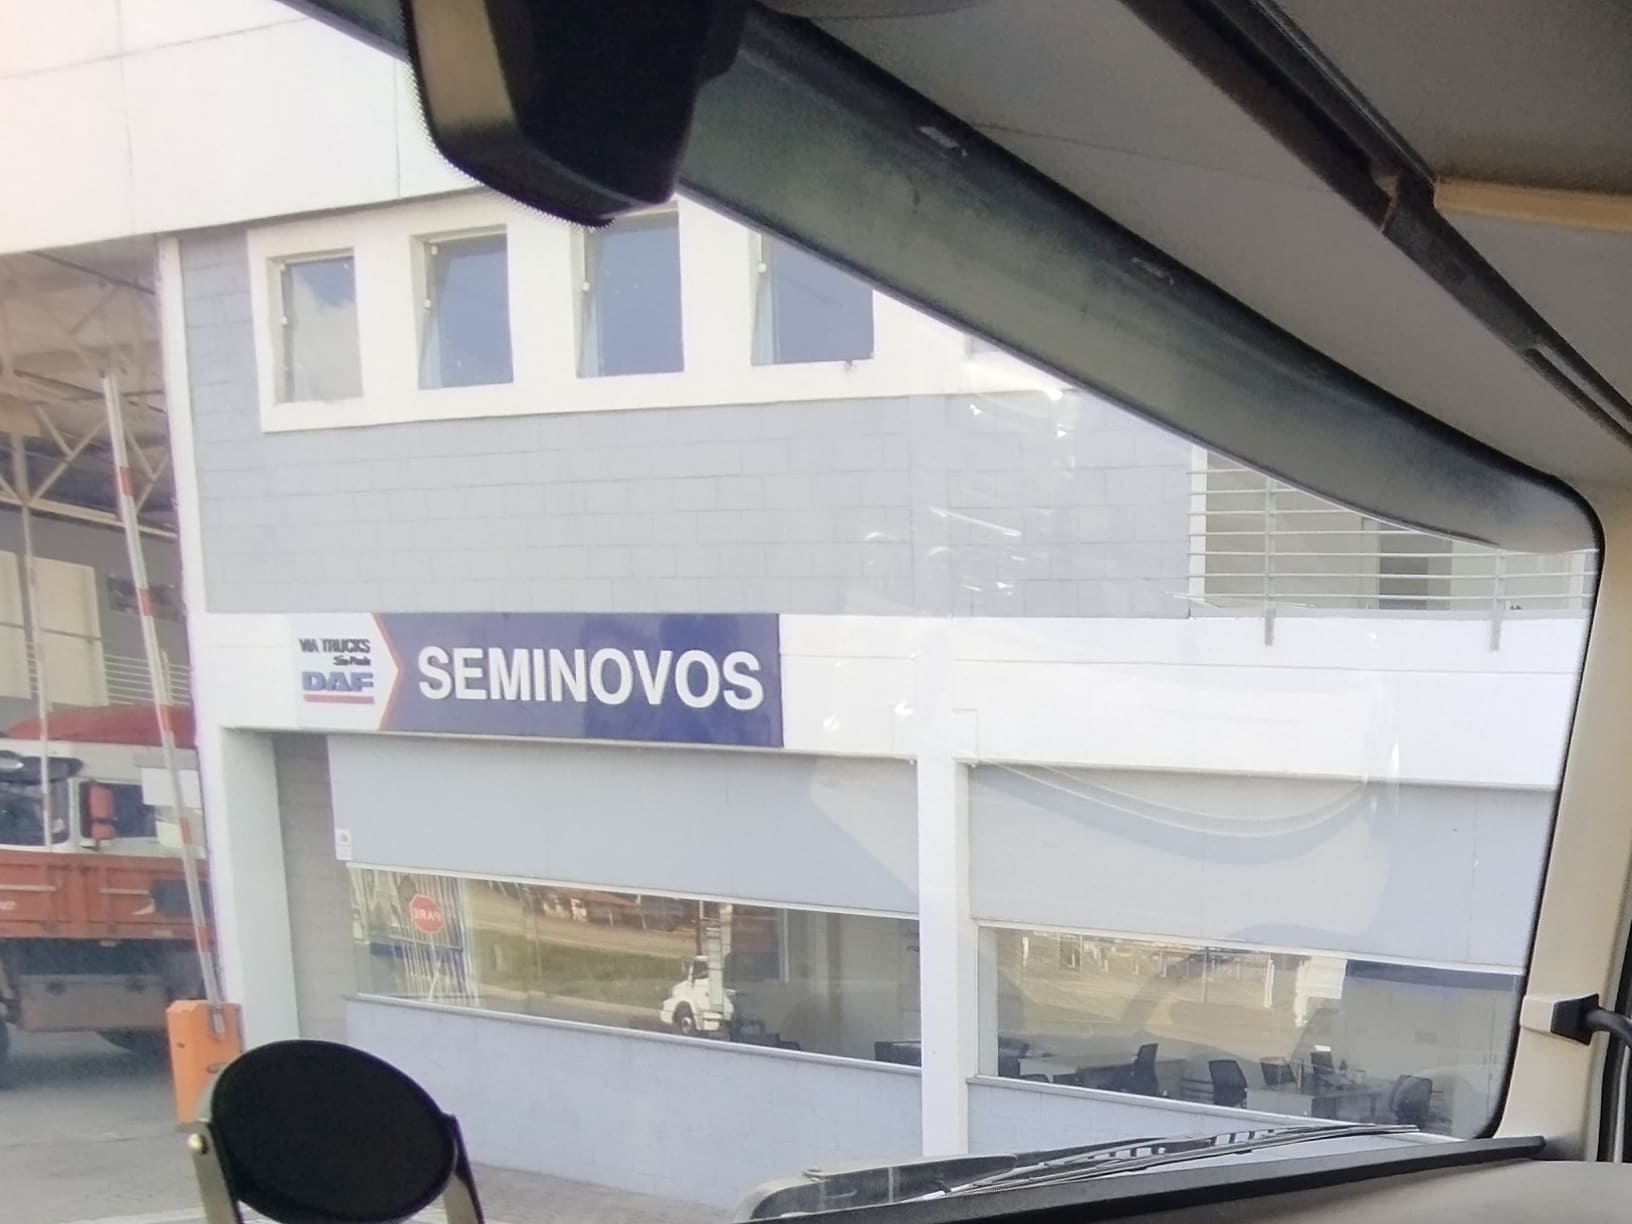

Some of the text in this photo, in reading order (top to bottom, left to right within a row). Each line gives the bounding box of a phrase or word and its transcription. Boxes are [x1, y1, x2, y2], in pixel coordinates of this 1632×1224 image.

[320, 638, 371, 654] TRUCKS
[302, 671, 374, 692] DAF
[417, 646, 765, 710] SEMINOVOS
